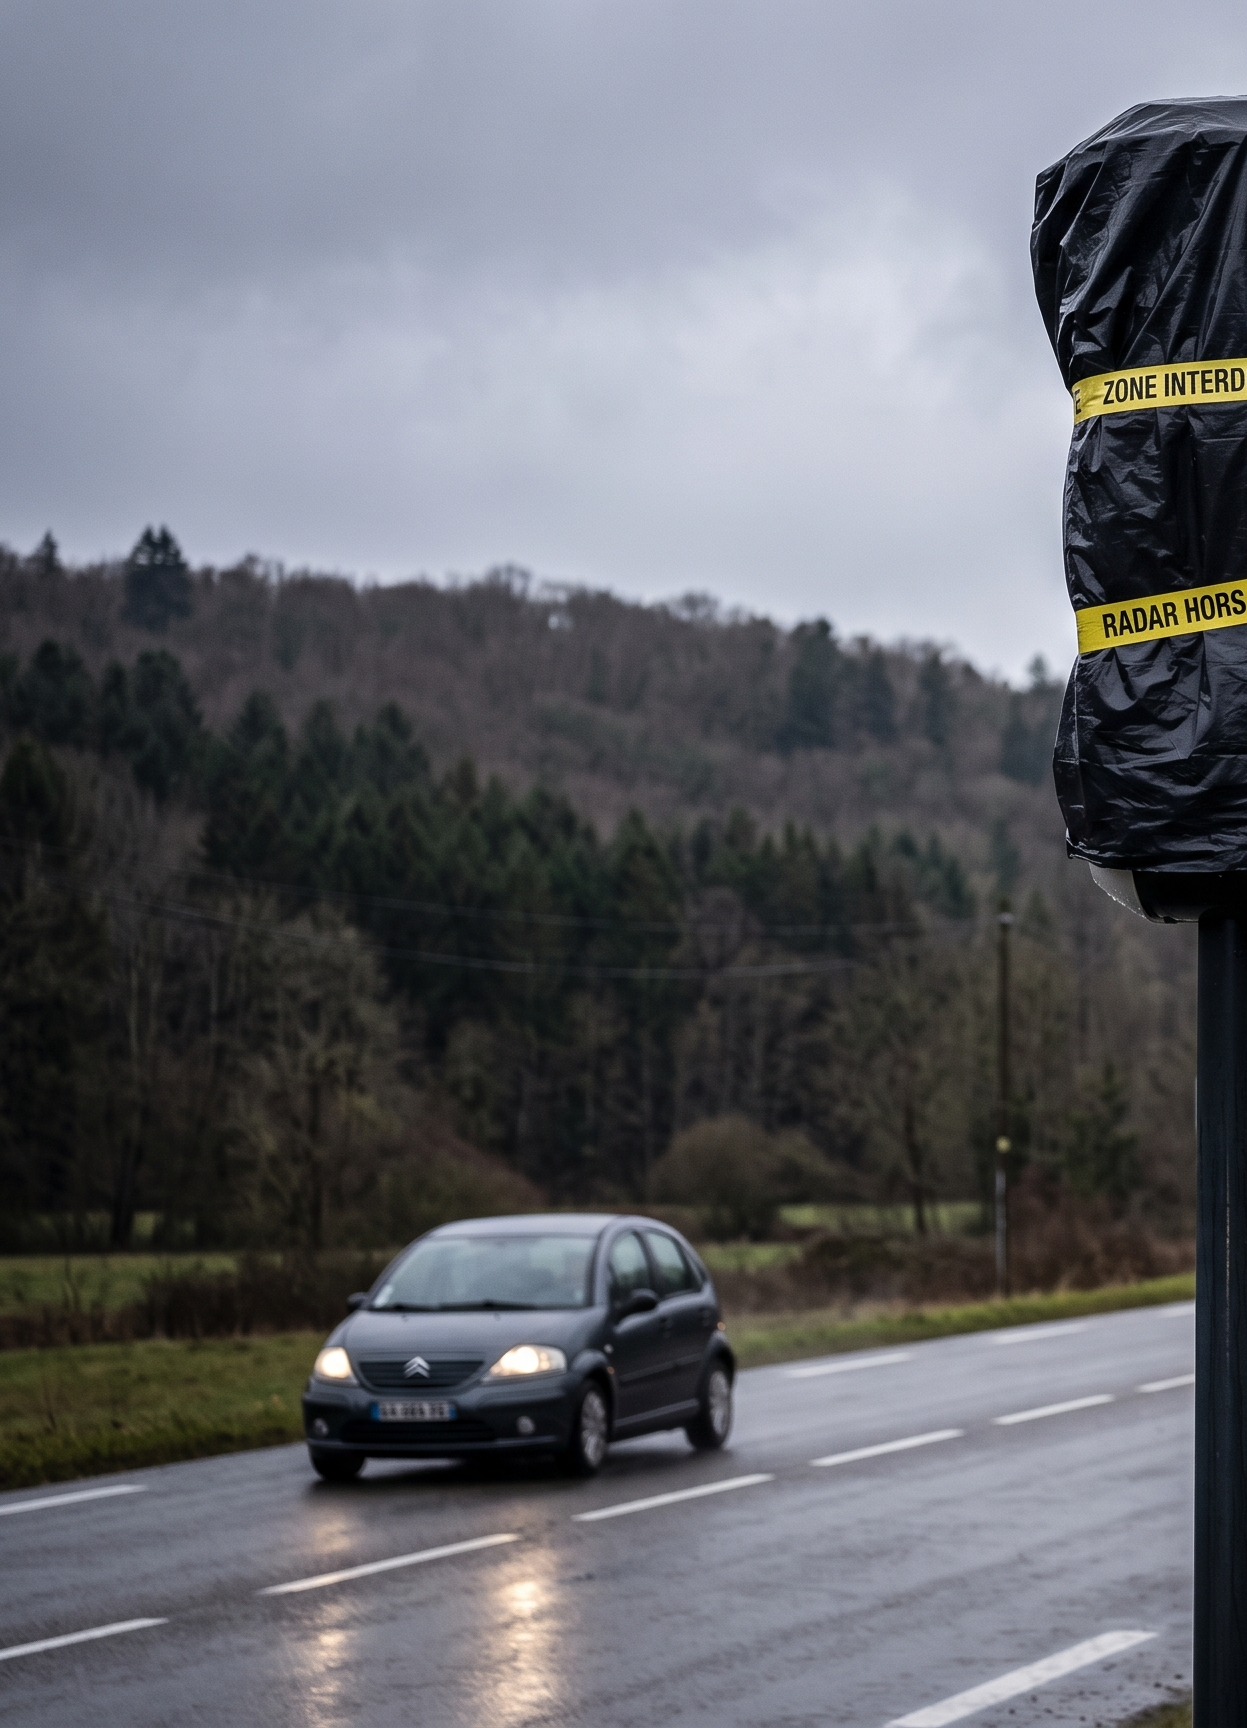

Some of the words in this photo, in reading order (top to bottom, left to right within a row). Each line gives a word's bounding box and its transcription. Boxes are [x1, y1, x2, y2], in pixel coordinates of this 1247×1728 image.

[1103, 374, 1158, 405] ZONE
[1102, 601, 1179, 638] RADAR
[1184, 589, 1247, 623] HORS
